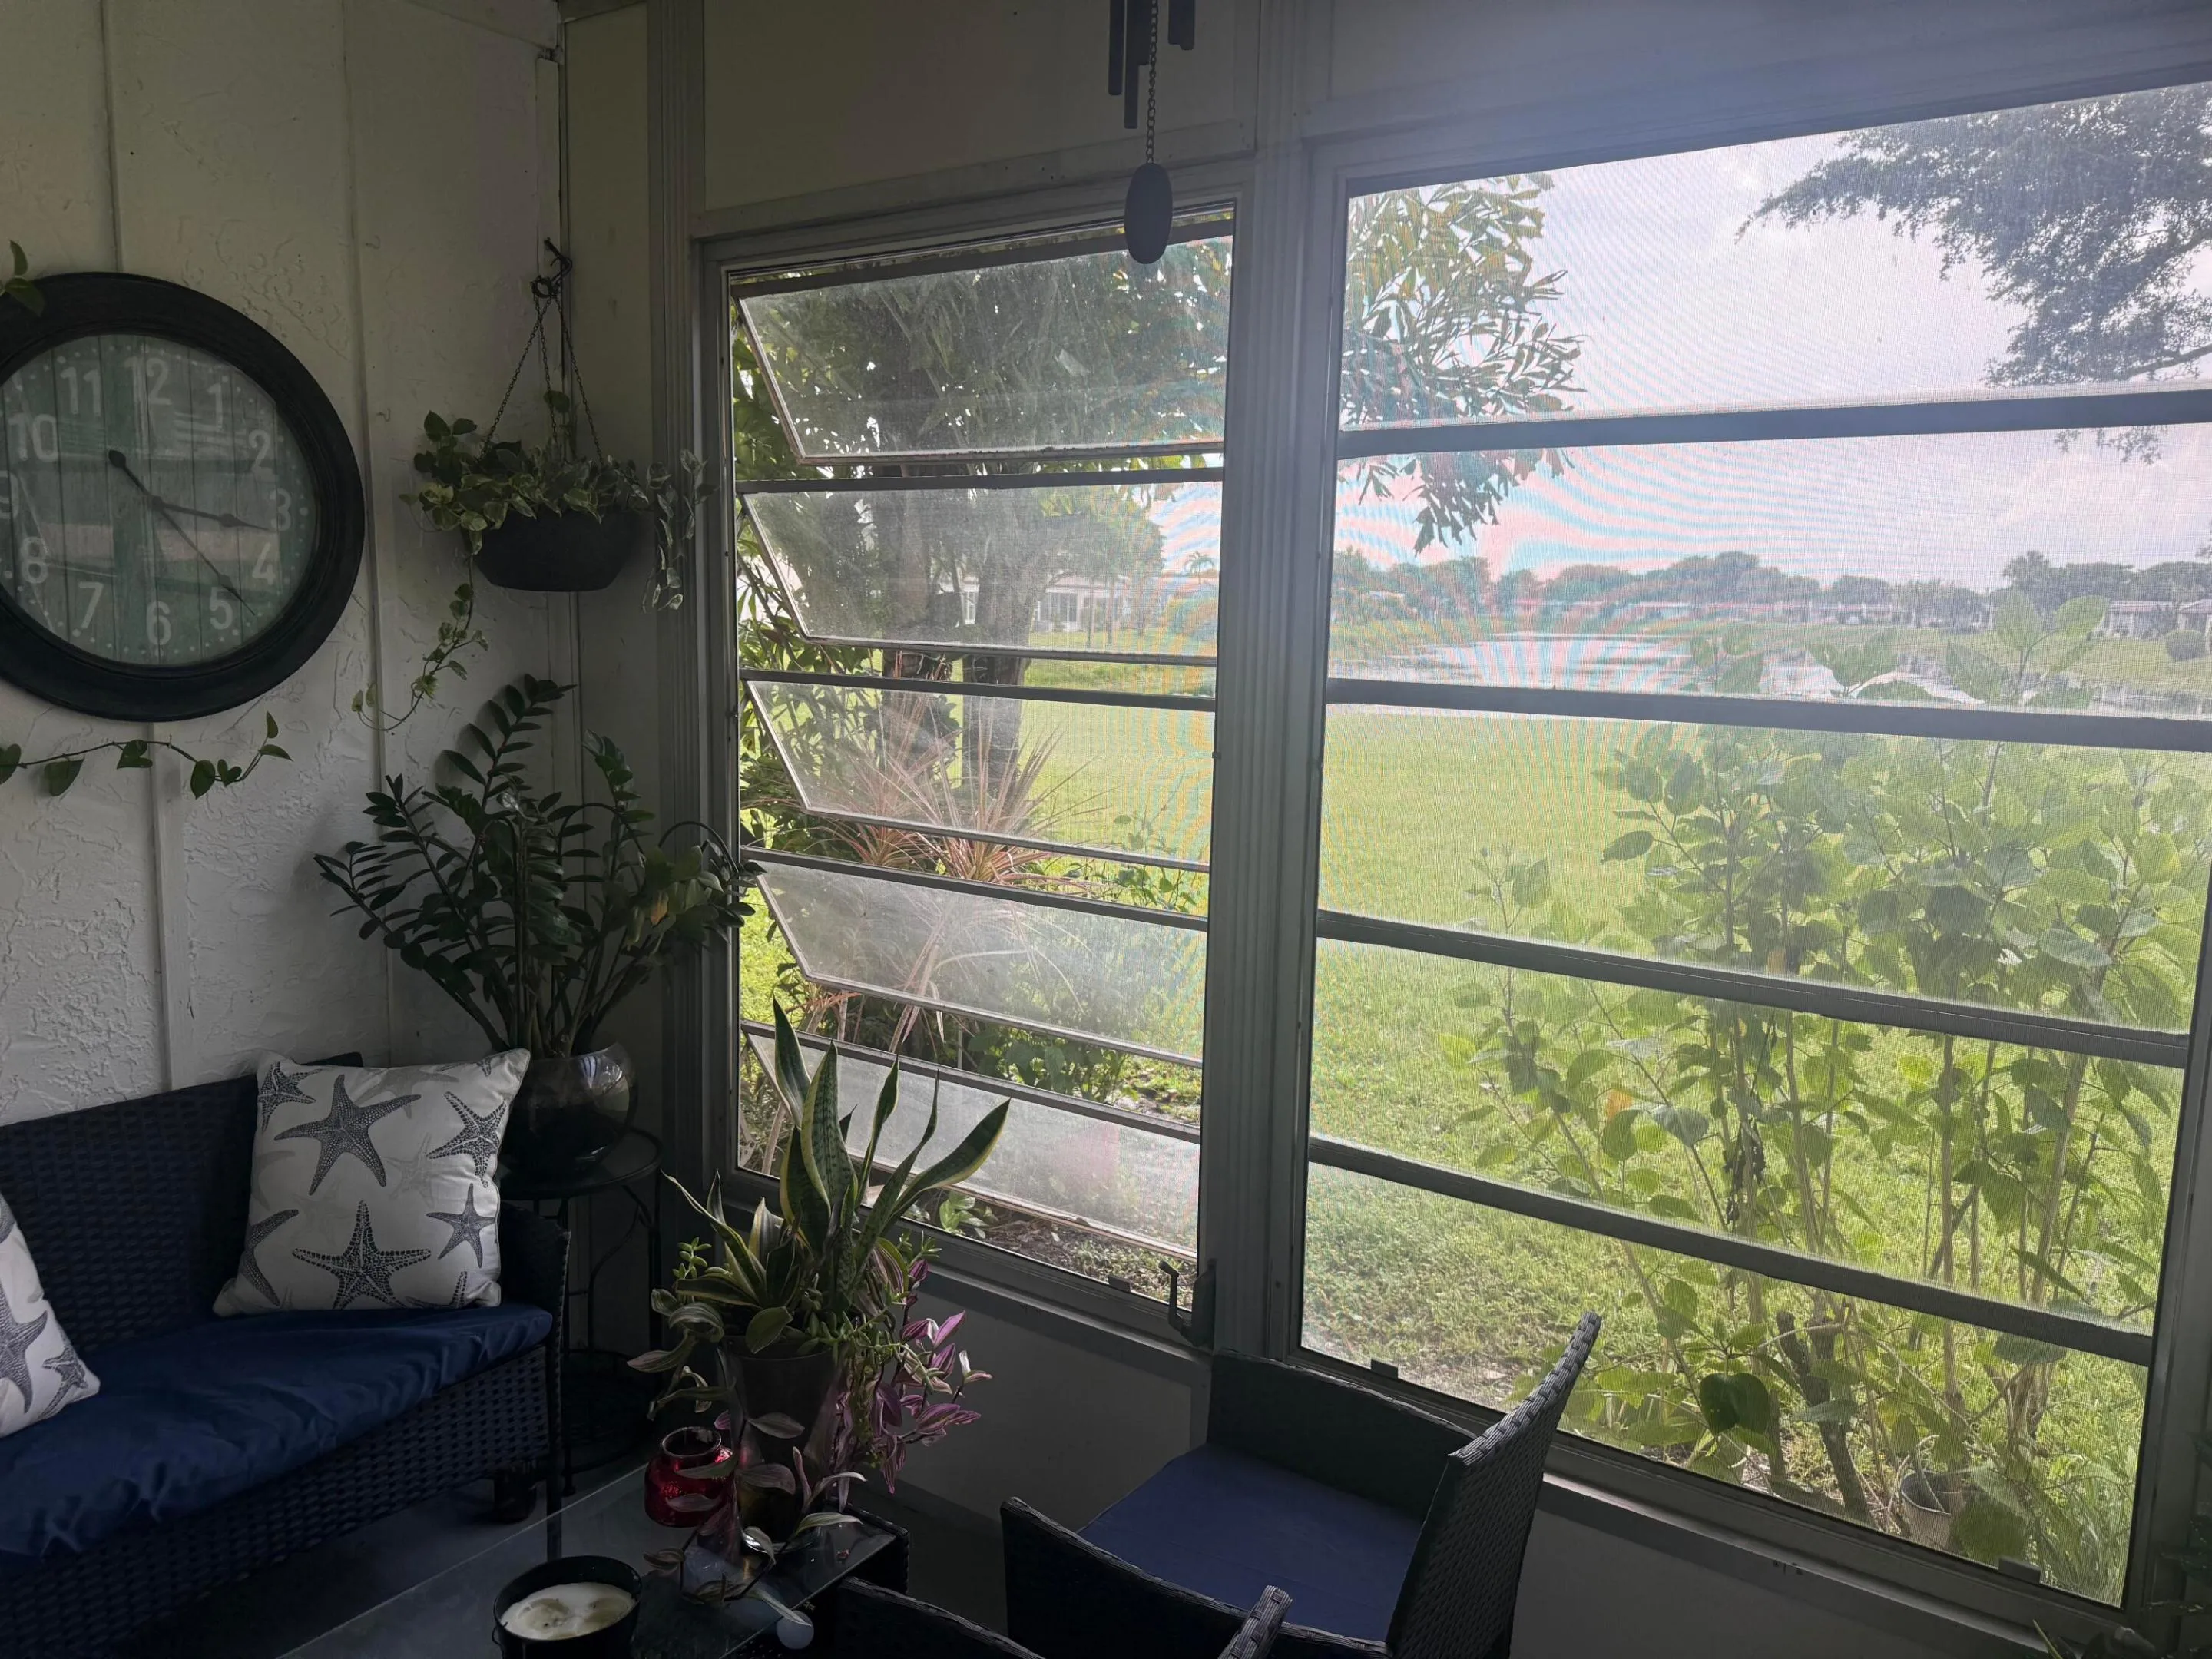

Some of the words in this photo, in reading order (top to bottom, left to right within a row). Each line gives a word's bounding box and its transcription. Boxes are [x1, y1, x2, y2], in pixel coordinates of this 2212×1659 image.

[60, 366, 102, 416] 11
[124, 356, 172, 406] 12
[207, 382, 224, 432] 1
[8, 414, 58, 461] 10
[248, 430, 277, 482] 2
[269, 488, 292, 531] 3
[22, 536, 49, 584] 8
[252, 542, 276, 586] 4
[78, 581, 104, 630] 7
[146, 601, 171, 645] 6
[209, 586, 233, 630] 5
